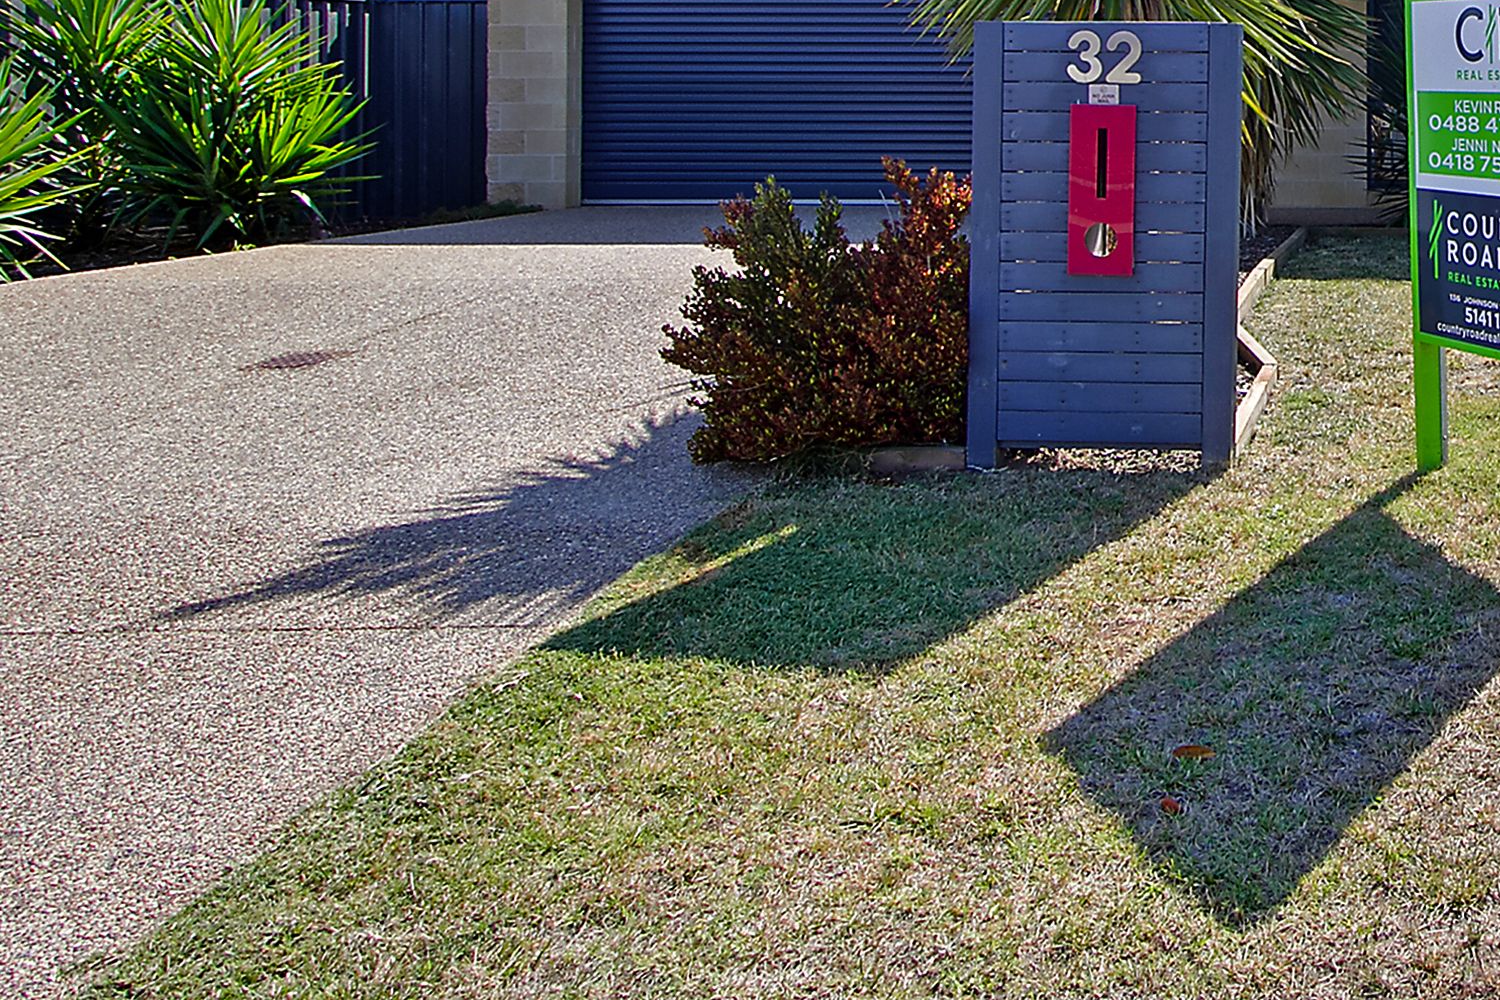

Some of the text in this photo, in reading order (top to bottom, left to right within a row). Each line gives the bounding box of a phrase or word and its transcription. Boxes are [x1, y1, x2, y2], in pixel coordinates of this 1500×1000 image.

[1066, 29, 1142, 84] 32
[1456, 70, 1483, 81] REAL
[1428, 114, 1480, 133] 0488
[1451, 138, 1488, 153] JENNI
[1428, 152, 1475, 171] 0418
[1447, 271, 1473, 286] REAL
